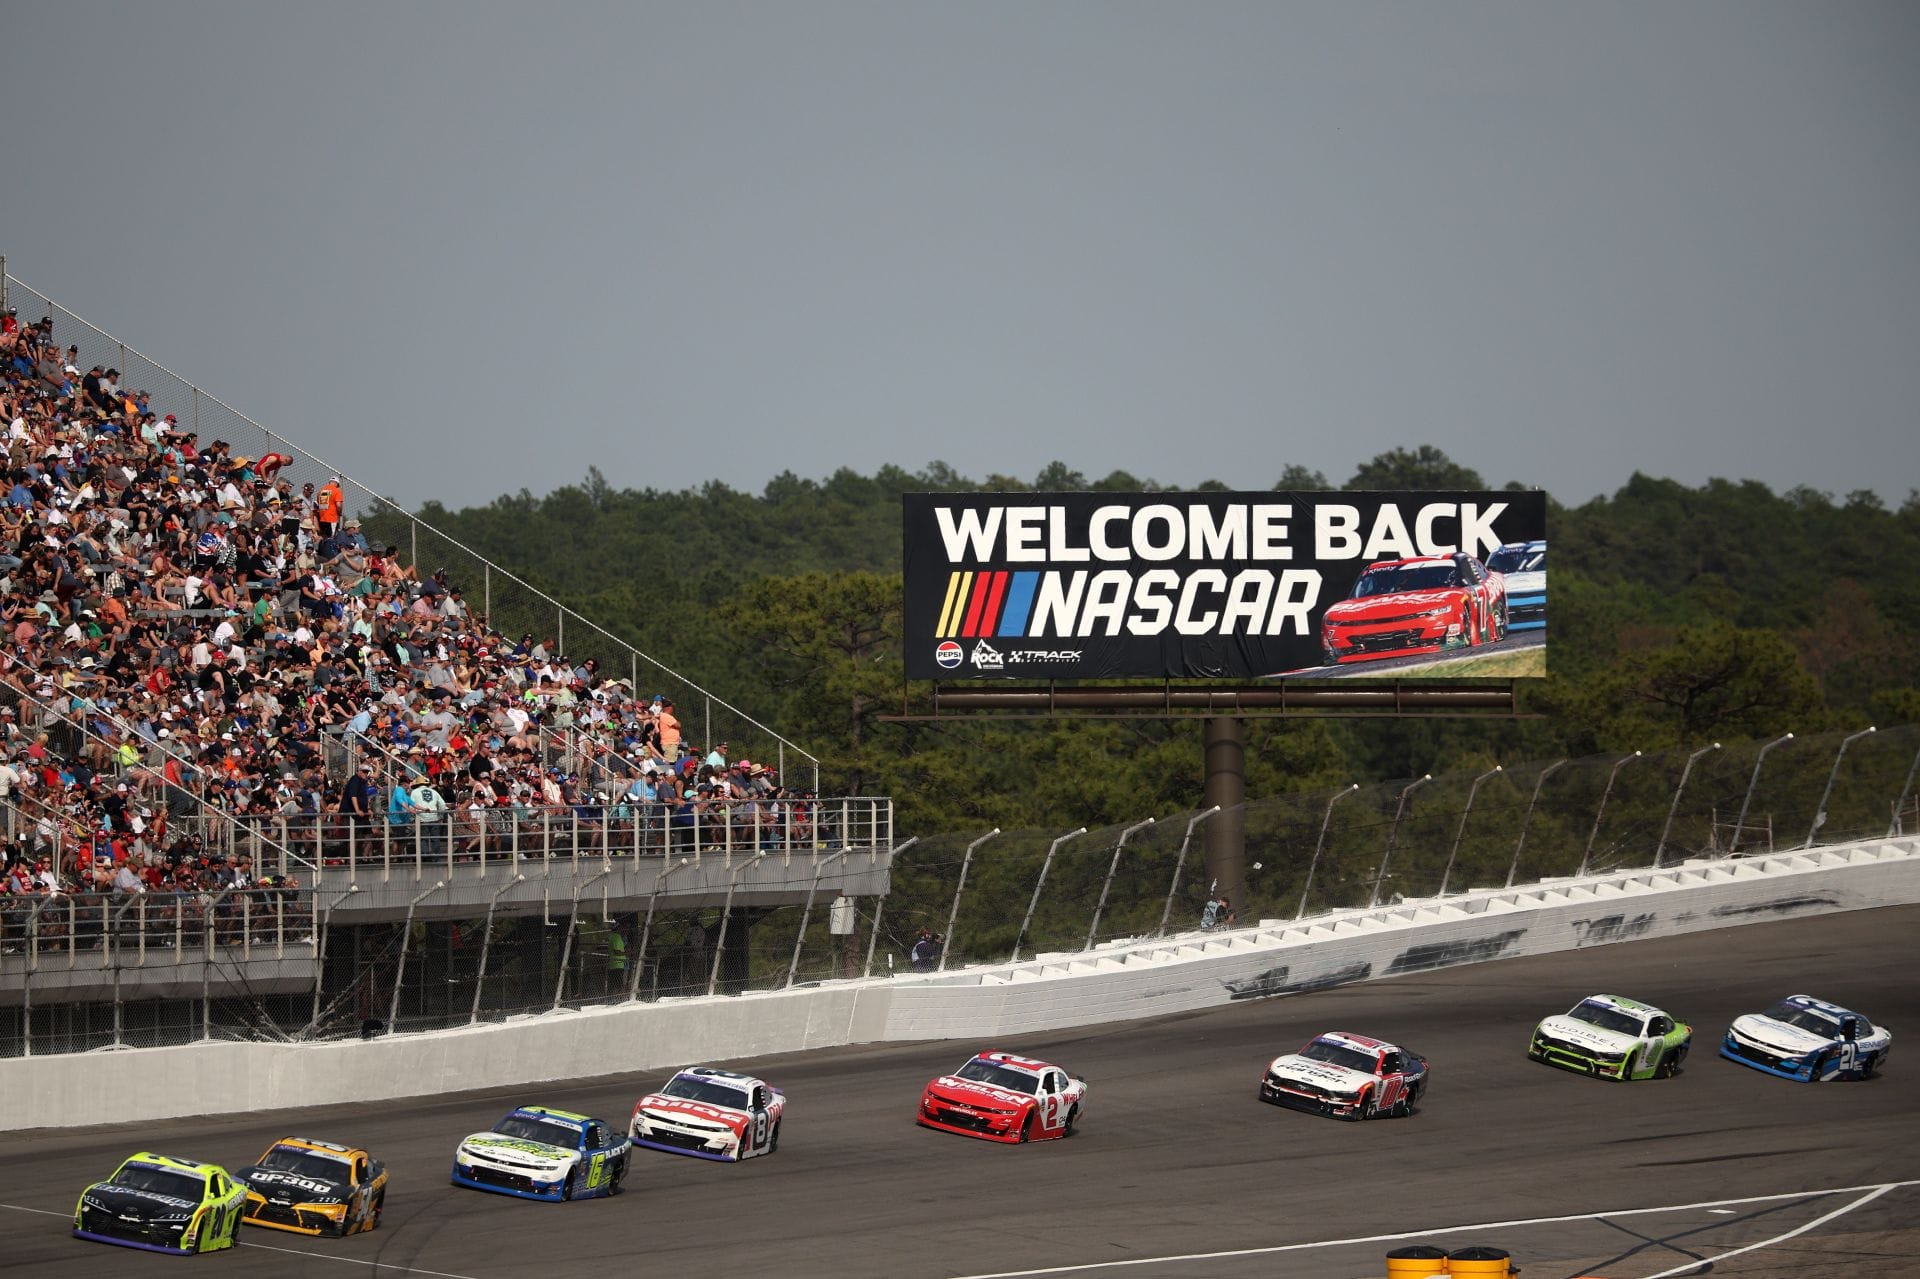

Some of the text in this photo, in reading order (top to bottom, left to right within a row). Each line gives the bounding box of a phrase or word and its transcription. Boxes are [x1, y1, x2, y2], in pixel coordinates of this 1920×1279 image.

[935, 502, 1508, 562] WELCOME BACK
[1368, 564, 1397, 575] xfinity
[1029, 569, 1322, 637] NASCAR
[970, 652, 1005, 669] ROCK
[1023, 650, 1083, 659] TRACK
[1543, 1022, 1619, 1050] AUDIBEL
[1839, 1043, 1855, 1070] 21
[937, 1077, 1031, 1105] WHELEN
[1046, 1096, 1058, 1128] 2
[755, 1113, 767, 1144] 8
[586, 1151, 606, 1189] 16
